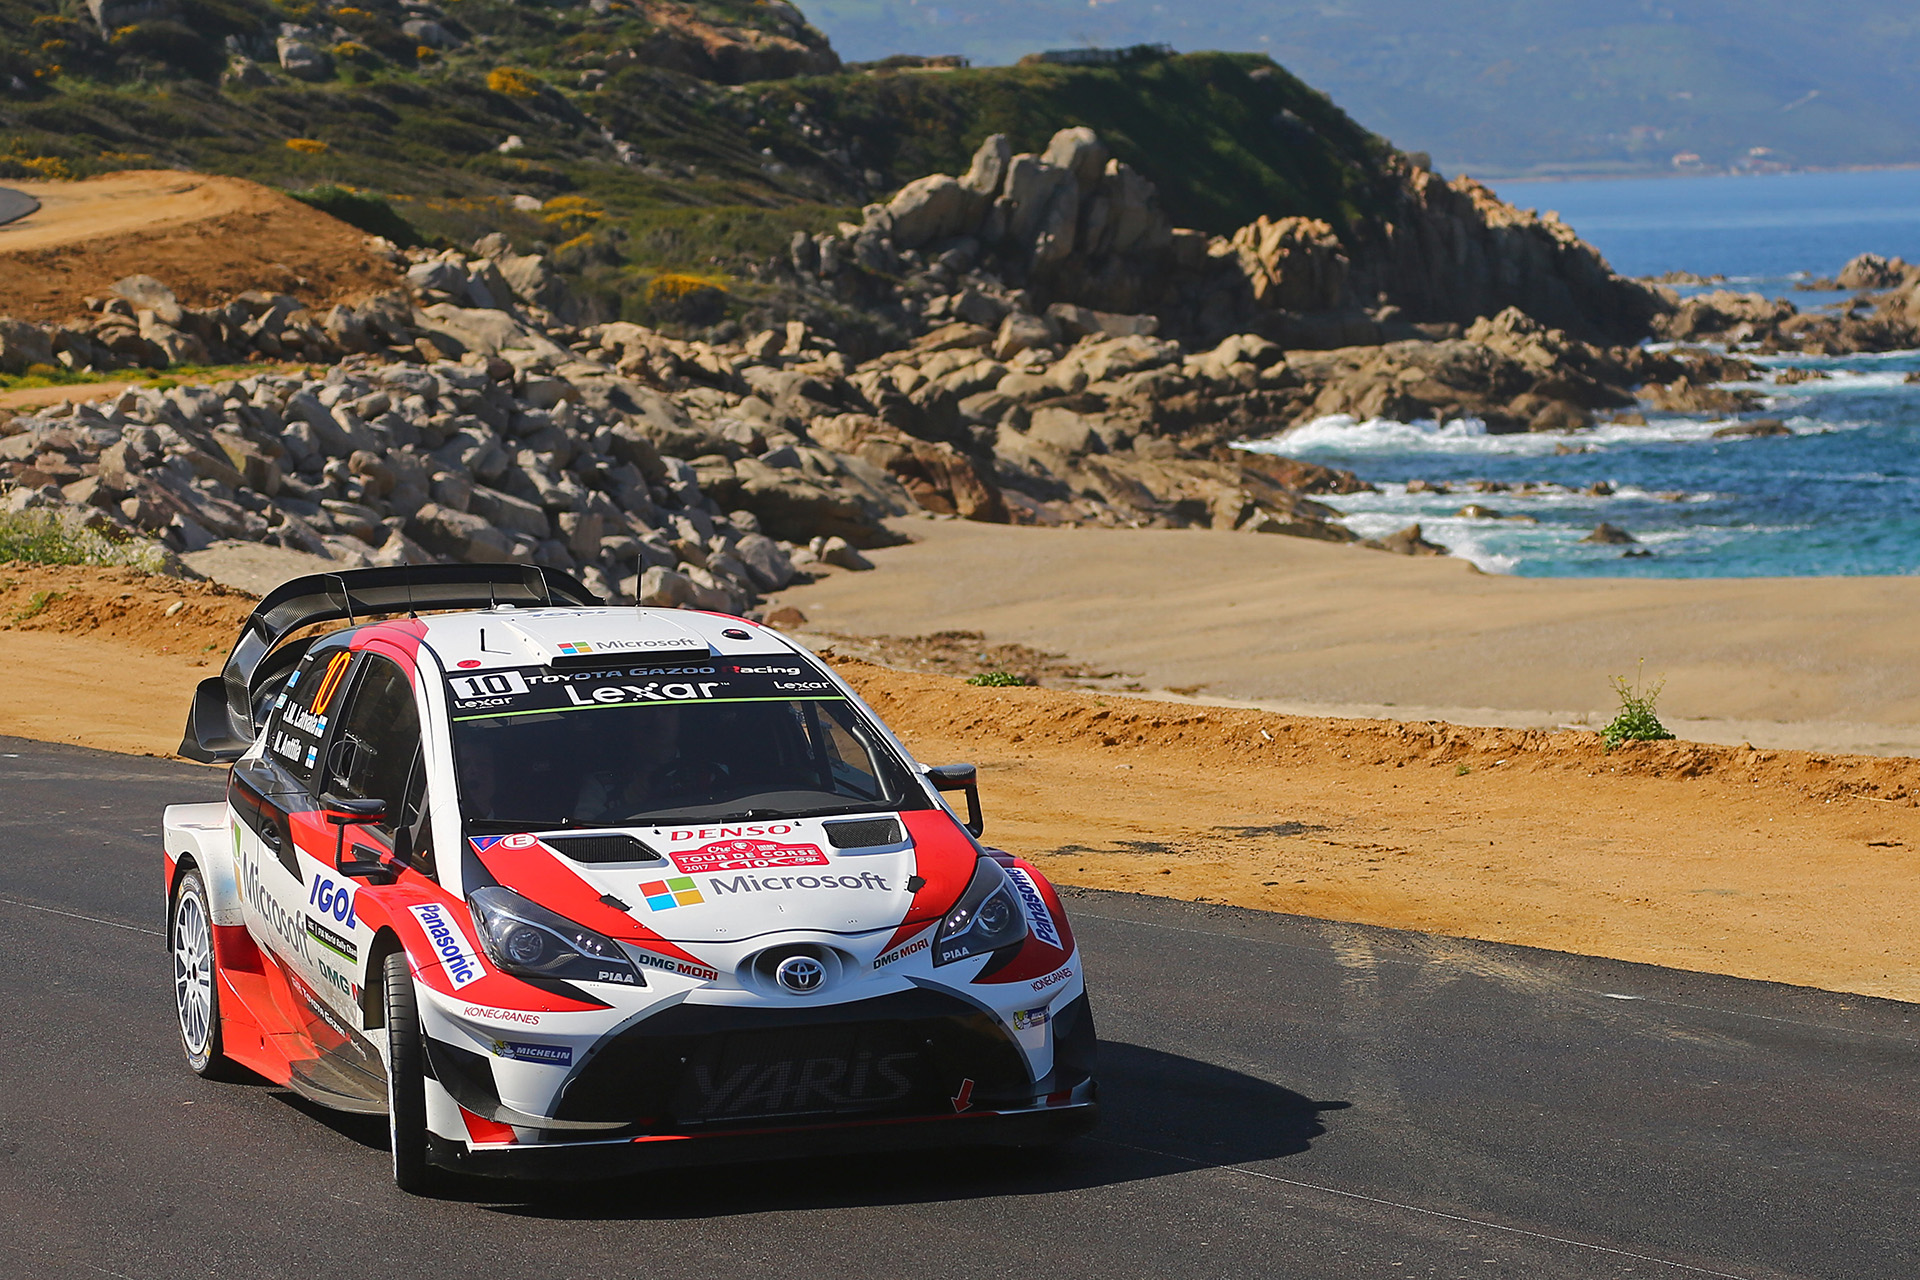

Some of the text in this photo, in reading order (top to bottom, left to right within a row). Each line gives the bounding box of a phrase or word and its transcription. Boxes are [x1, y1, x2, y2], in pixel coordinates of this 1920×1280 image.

[595, 638, 698, 650] Microsoft
[310, 651, 351, 715] 10
[523, 669, 623, 684] TOYOTA
[629, 666, 716, 677] GAZOO
[465, 675, 513, 696] 10
[563, 681, 720, 706] Lexar
[773, 681, 830, 690] Lexar
[454, 697, 513, 709] Lexar
[512, 836, 527, 846] E
[670, 824, 792, 841] DENSO
[677, 854, 728, 864] TOUR
[761, 848, 818, 857] CORSE
[684, 864, 709, 872] 2017
[740, 859, 768, 868] 10
[708, 871, 892, 895] Microsoft
[243, 851, 313, 966] Microsoft
[310, 873, 357, 930] IGOL
[1008, 867, 1059, 946] Panasonic
[415, 904, 475, 983] Panasonic
[942, 946, 970, 961] PIAA
[873, 938, 930, 970] DMG MORI
[318, 957, 350, 996] DMG
[598, 971, 635, 984] PIAA
[638, 954, 719, 981] DMG MORI
[1030, 967, 1073, 992] KONECRANES
[463, 1006, 541, 1026] KONECRANES
[515, 1046, 571, 1060] MICHELIN
